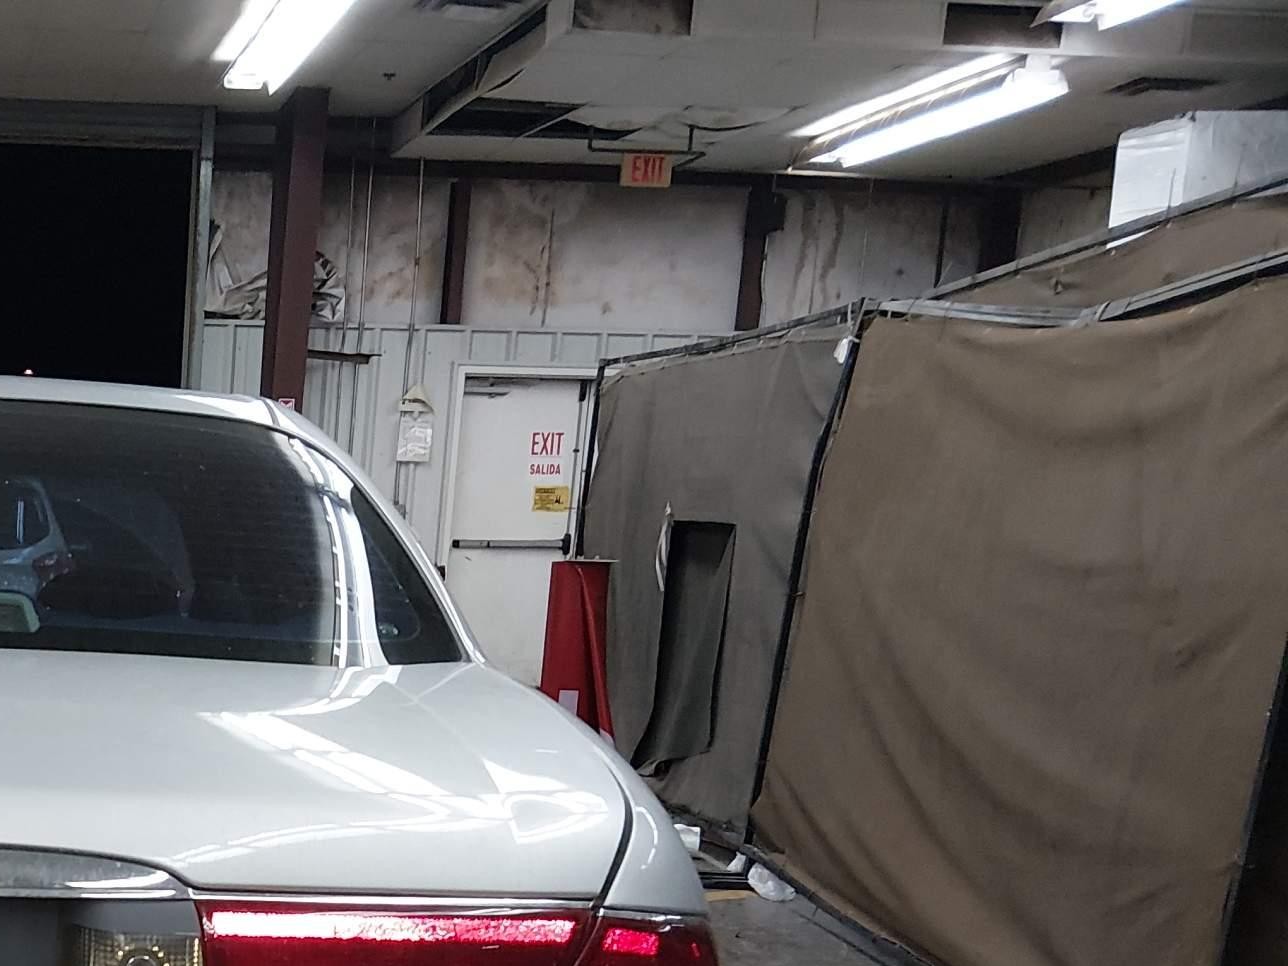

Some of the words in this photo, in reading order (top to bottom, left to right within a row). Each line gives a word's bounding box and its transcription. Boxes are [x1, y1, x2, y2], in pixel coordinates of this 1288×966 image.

[631, 155, 666, 183] EXIT
[530, 432, 565, 456] EXIT
[529, 463, 561, 475] SALIDA
